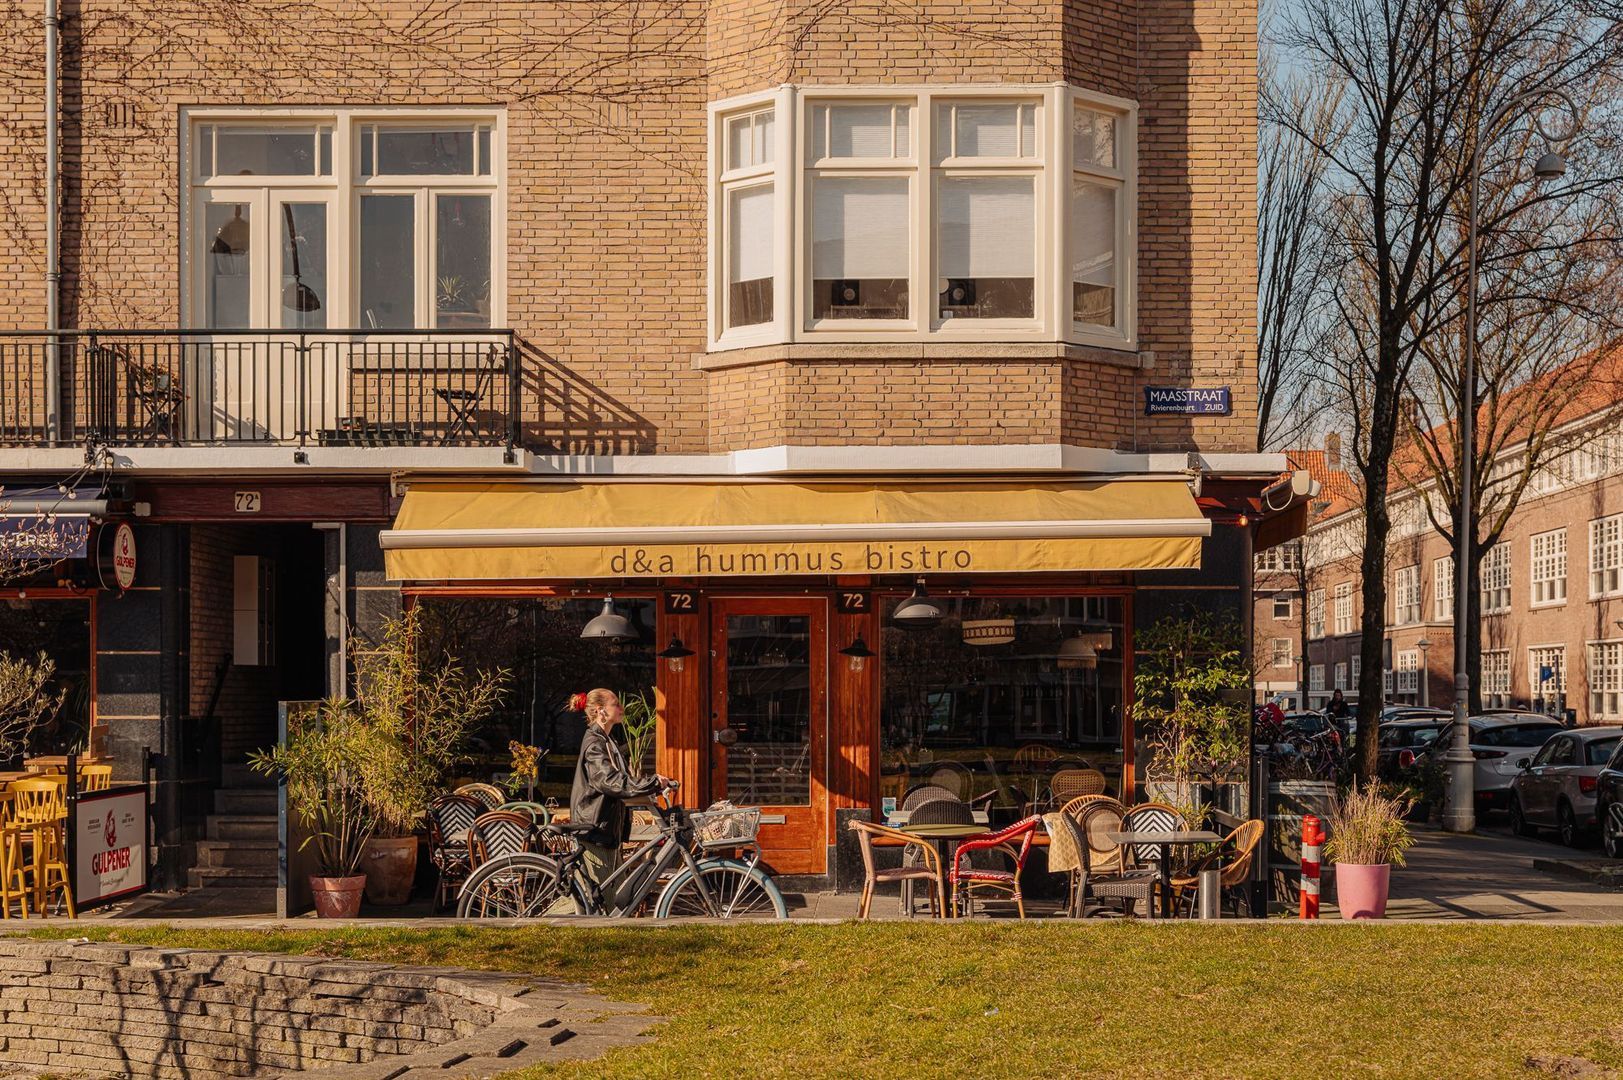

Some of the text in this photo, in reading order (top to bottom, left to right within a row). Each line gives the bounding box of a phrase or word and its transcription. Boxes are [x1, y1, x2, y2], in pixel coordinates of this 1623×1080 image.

[1151, 391, 1223, 401] MAASSTRAAT
[610, 544, 972, 573] d&a hummus bistro
[671, 594, 692, 608] 72
[843, 593, 863, 608] 72
[92, 847, 131, 875] GULPENER
